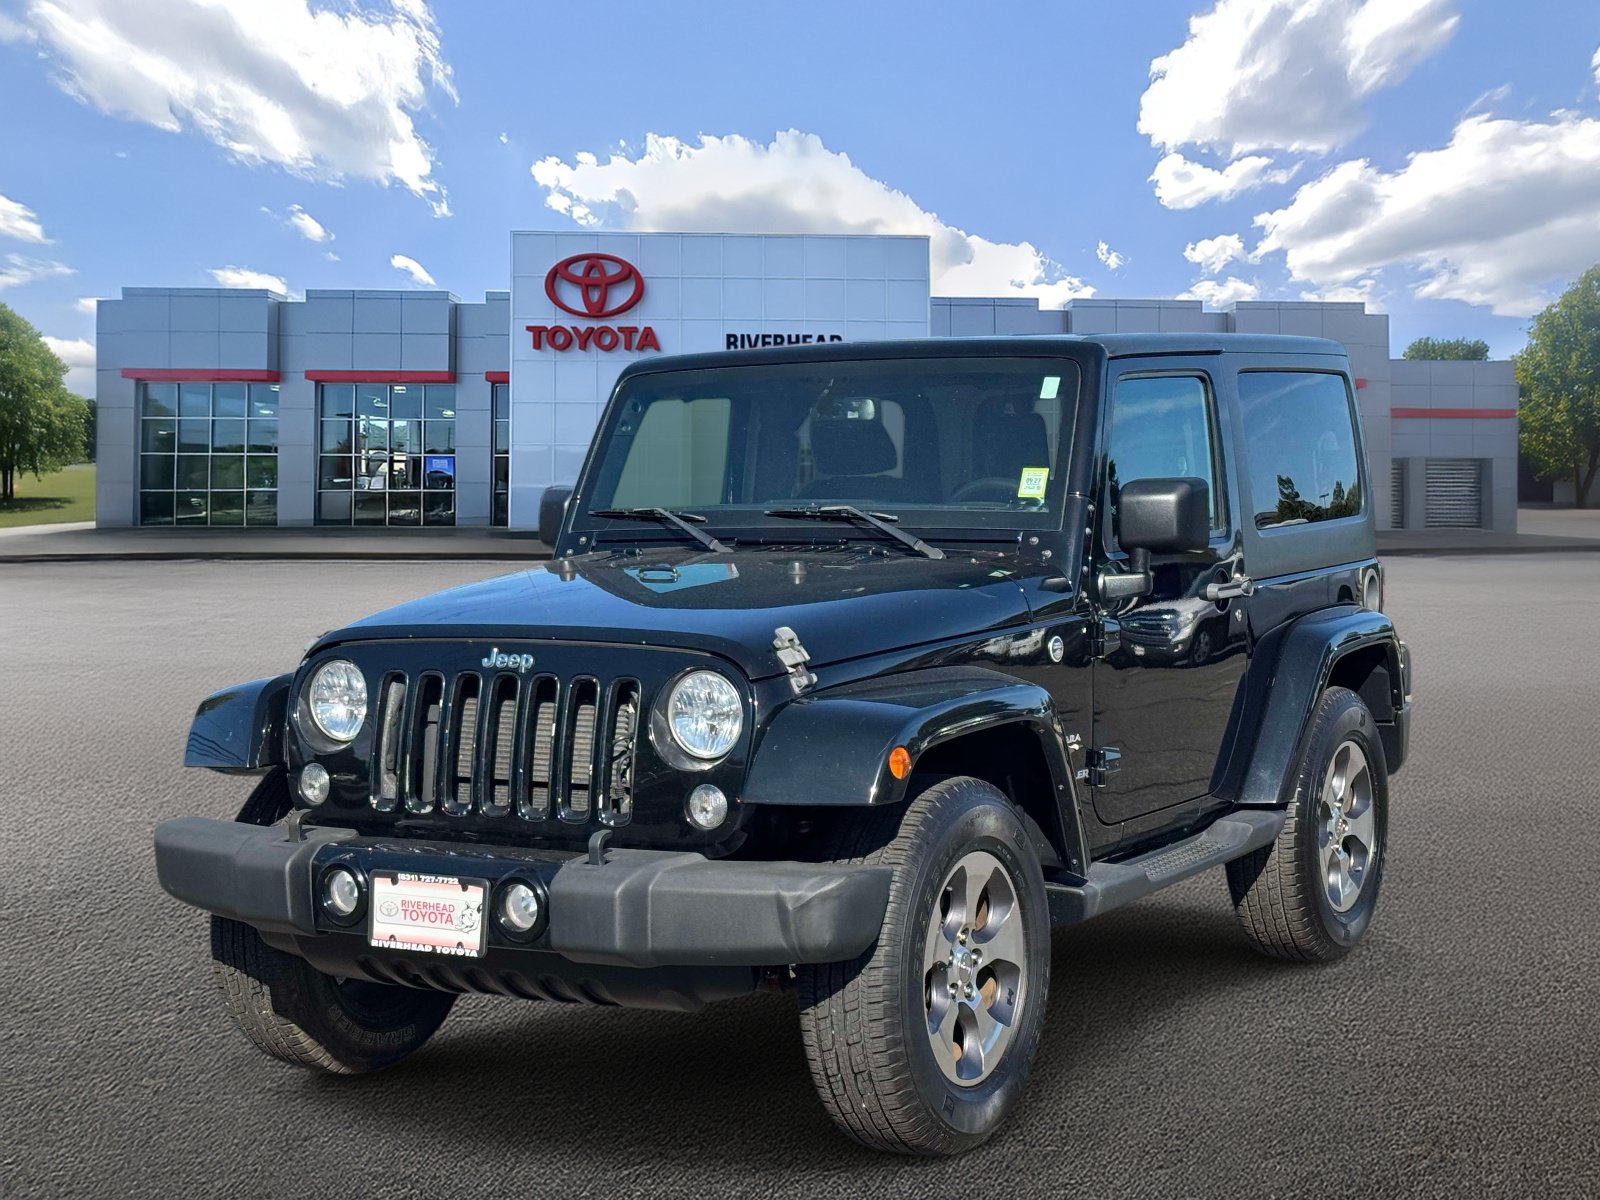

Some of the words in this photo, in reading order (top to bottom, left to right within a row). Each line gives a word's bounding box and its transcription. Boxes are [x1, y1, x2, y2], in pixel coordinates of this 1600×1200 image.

[526, 325, 662, 351] TOYOTA
[481, 647, 534, 673] Jeep
[401, 899, 455, 913] RIVERHEAD
[401, 909, 454, 926] TOYOTA
[371, 939, 433, 953] RIVERHEAD
[435, 945, 478, 958] TOYOTA
